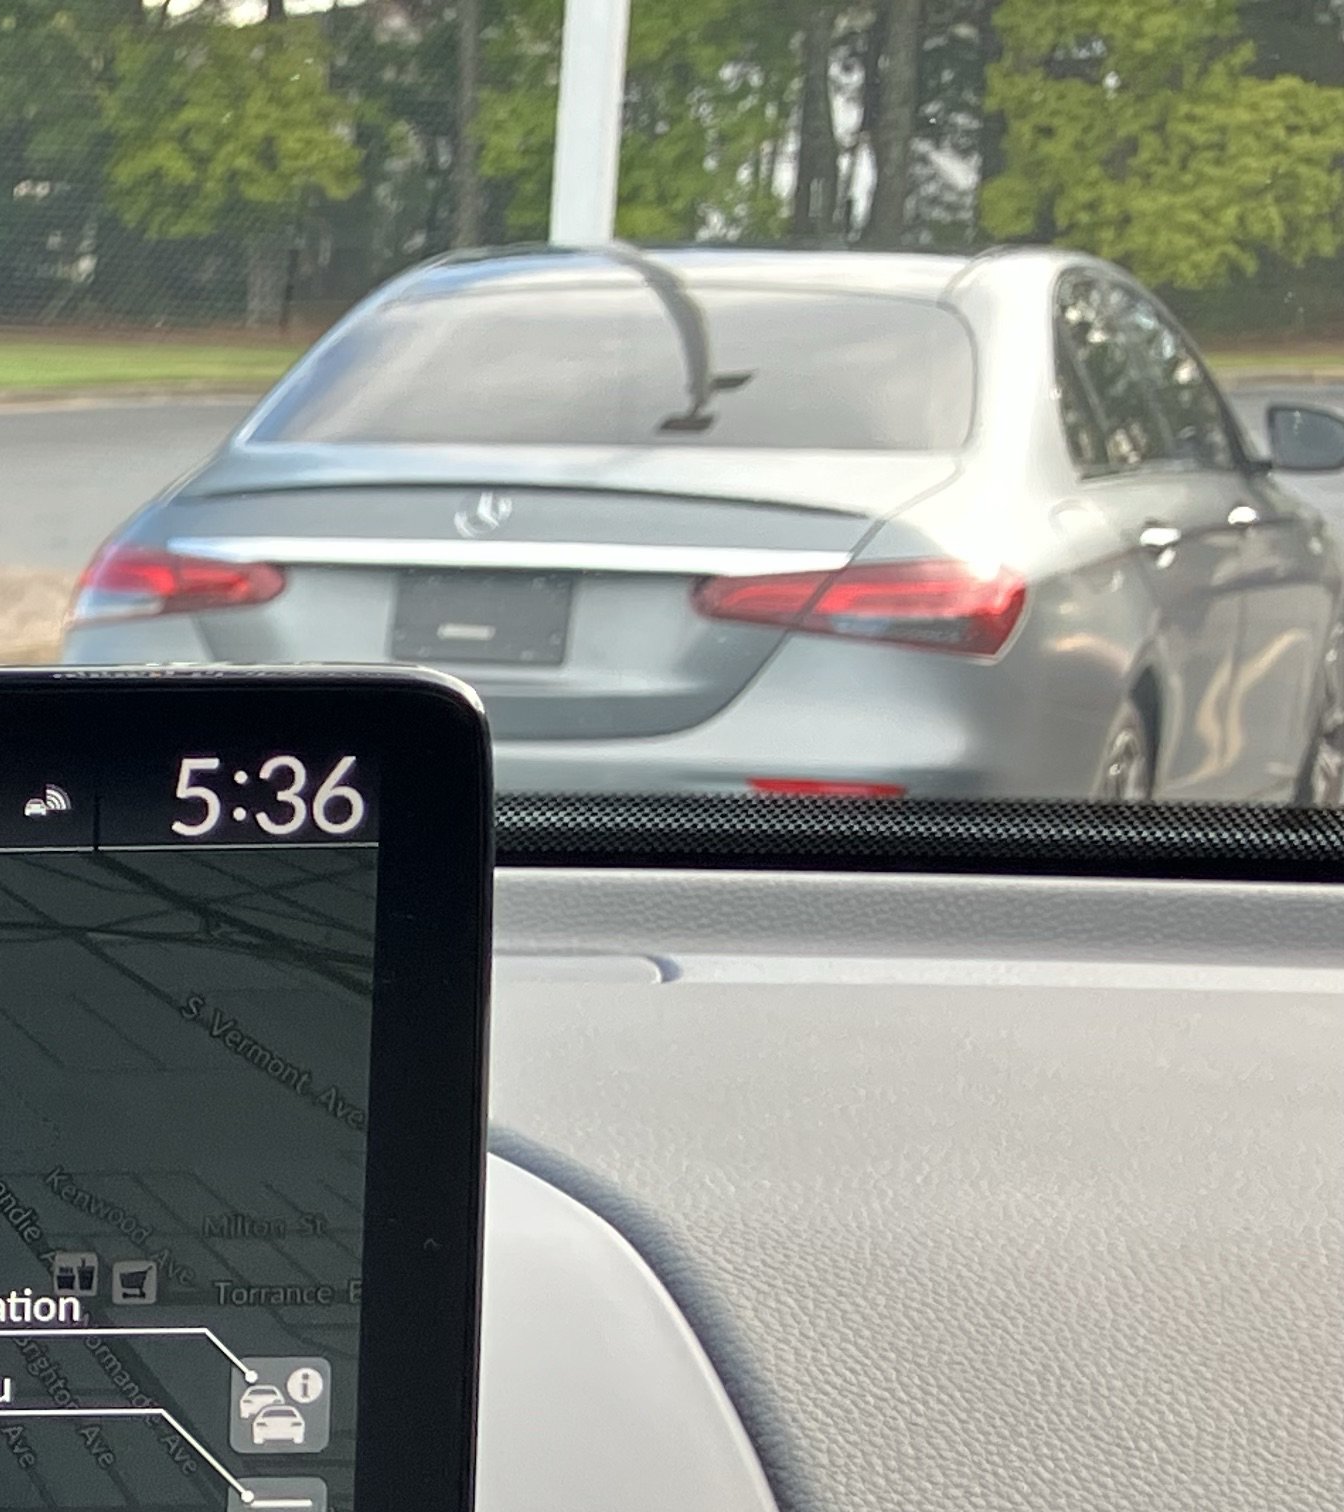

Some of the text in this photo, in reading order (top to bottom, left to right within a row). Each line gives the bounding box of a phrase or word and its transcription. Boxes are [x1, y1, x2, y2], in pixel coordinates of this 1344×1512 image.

[171, 755, 365, 836] 5:36
[210, 1010, 311, 1097] Vermont
[316, 1085, 366, 1130] Ave
[45, 1168, 154, 1245] Kenwood
[215, 1281, 333, 1305] Torrance
[1, 1425, 36, 1469] Ave
[80, 1425, 115, 1469] Ave
[162, 1434, 198, 1475] Ave
